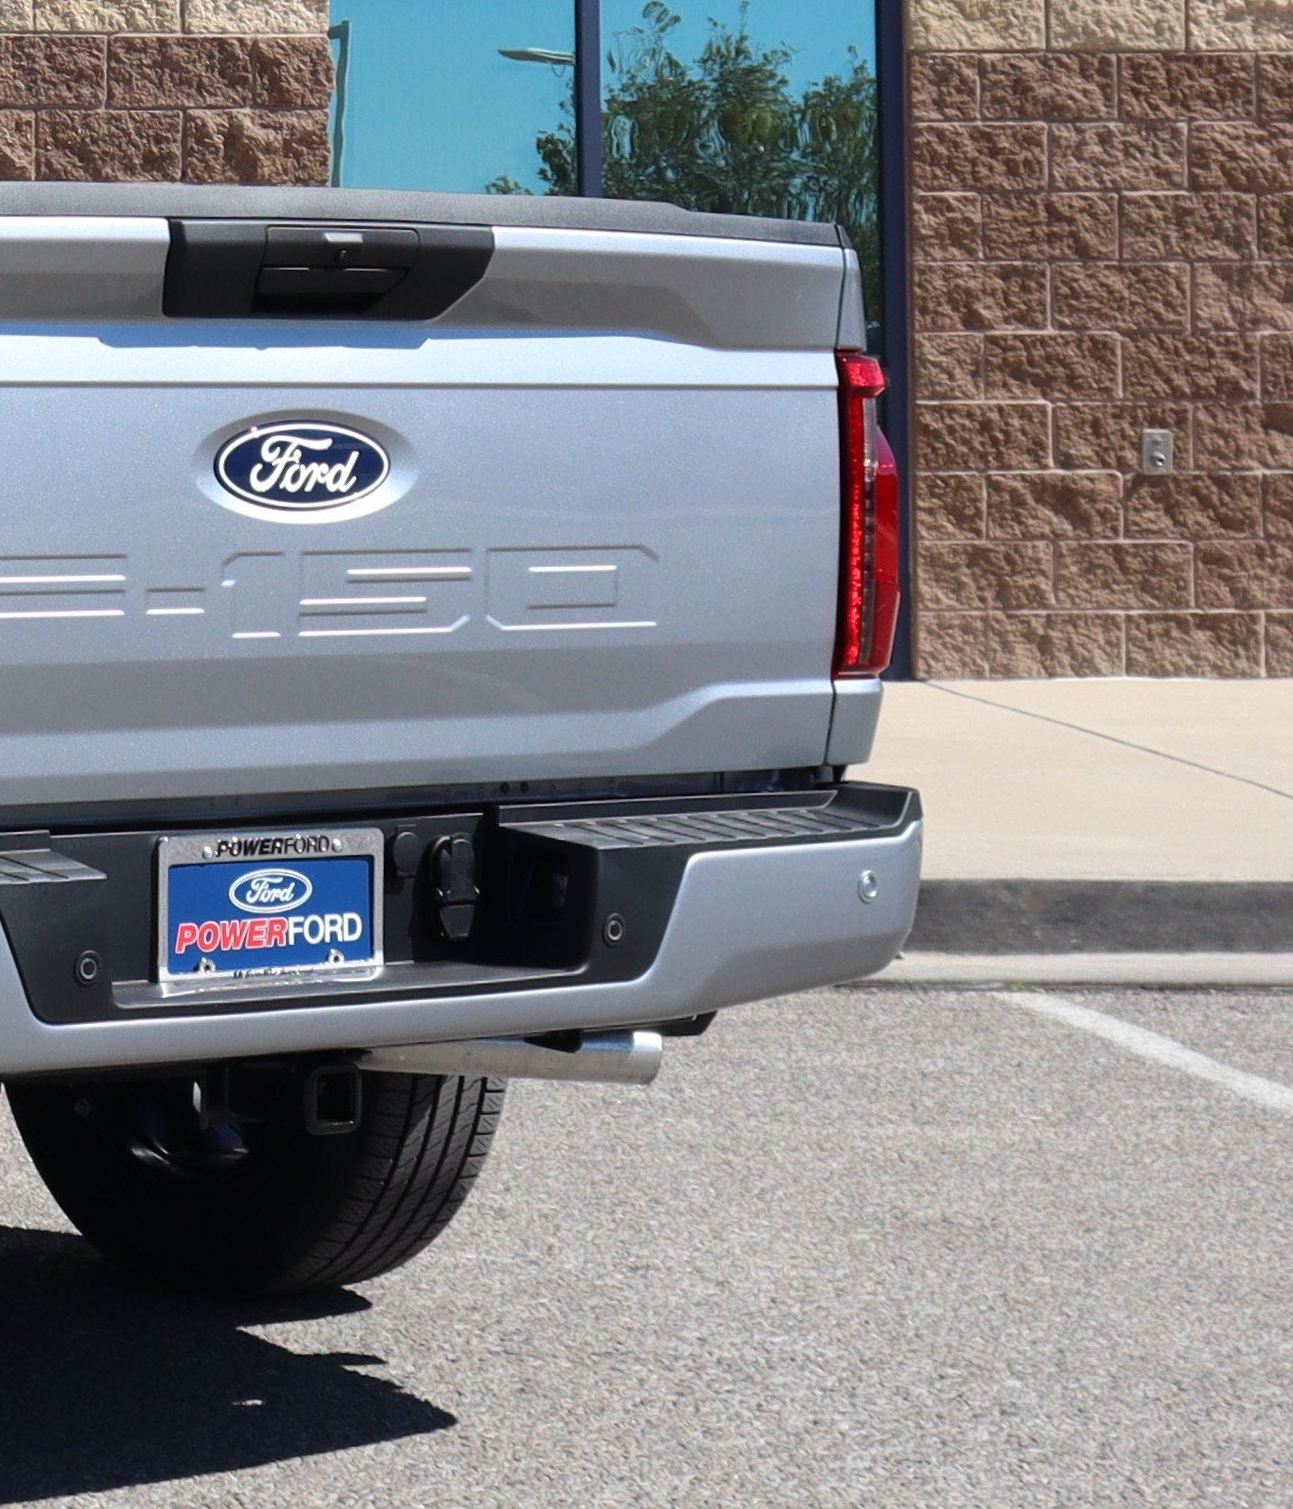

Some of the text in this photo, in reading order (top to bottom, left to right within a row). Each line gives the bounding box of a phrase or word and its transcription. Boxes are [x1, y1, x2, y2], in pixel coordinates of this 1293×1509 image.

[249, 433, 361, 495] Ford
[245, 876, 296, 904] Ford
[175, 912, 363, 954] POWERFORD
